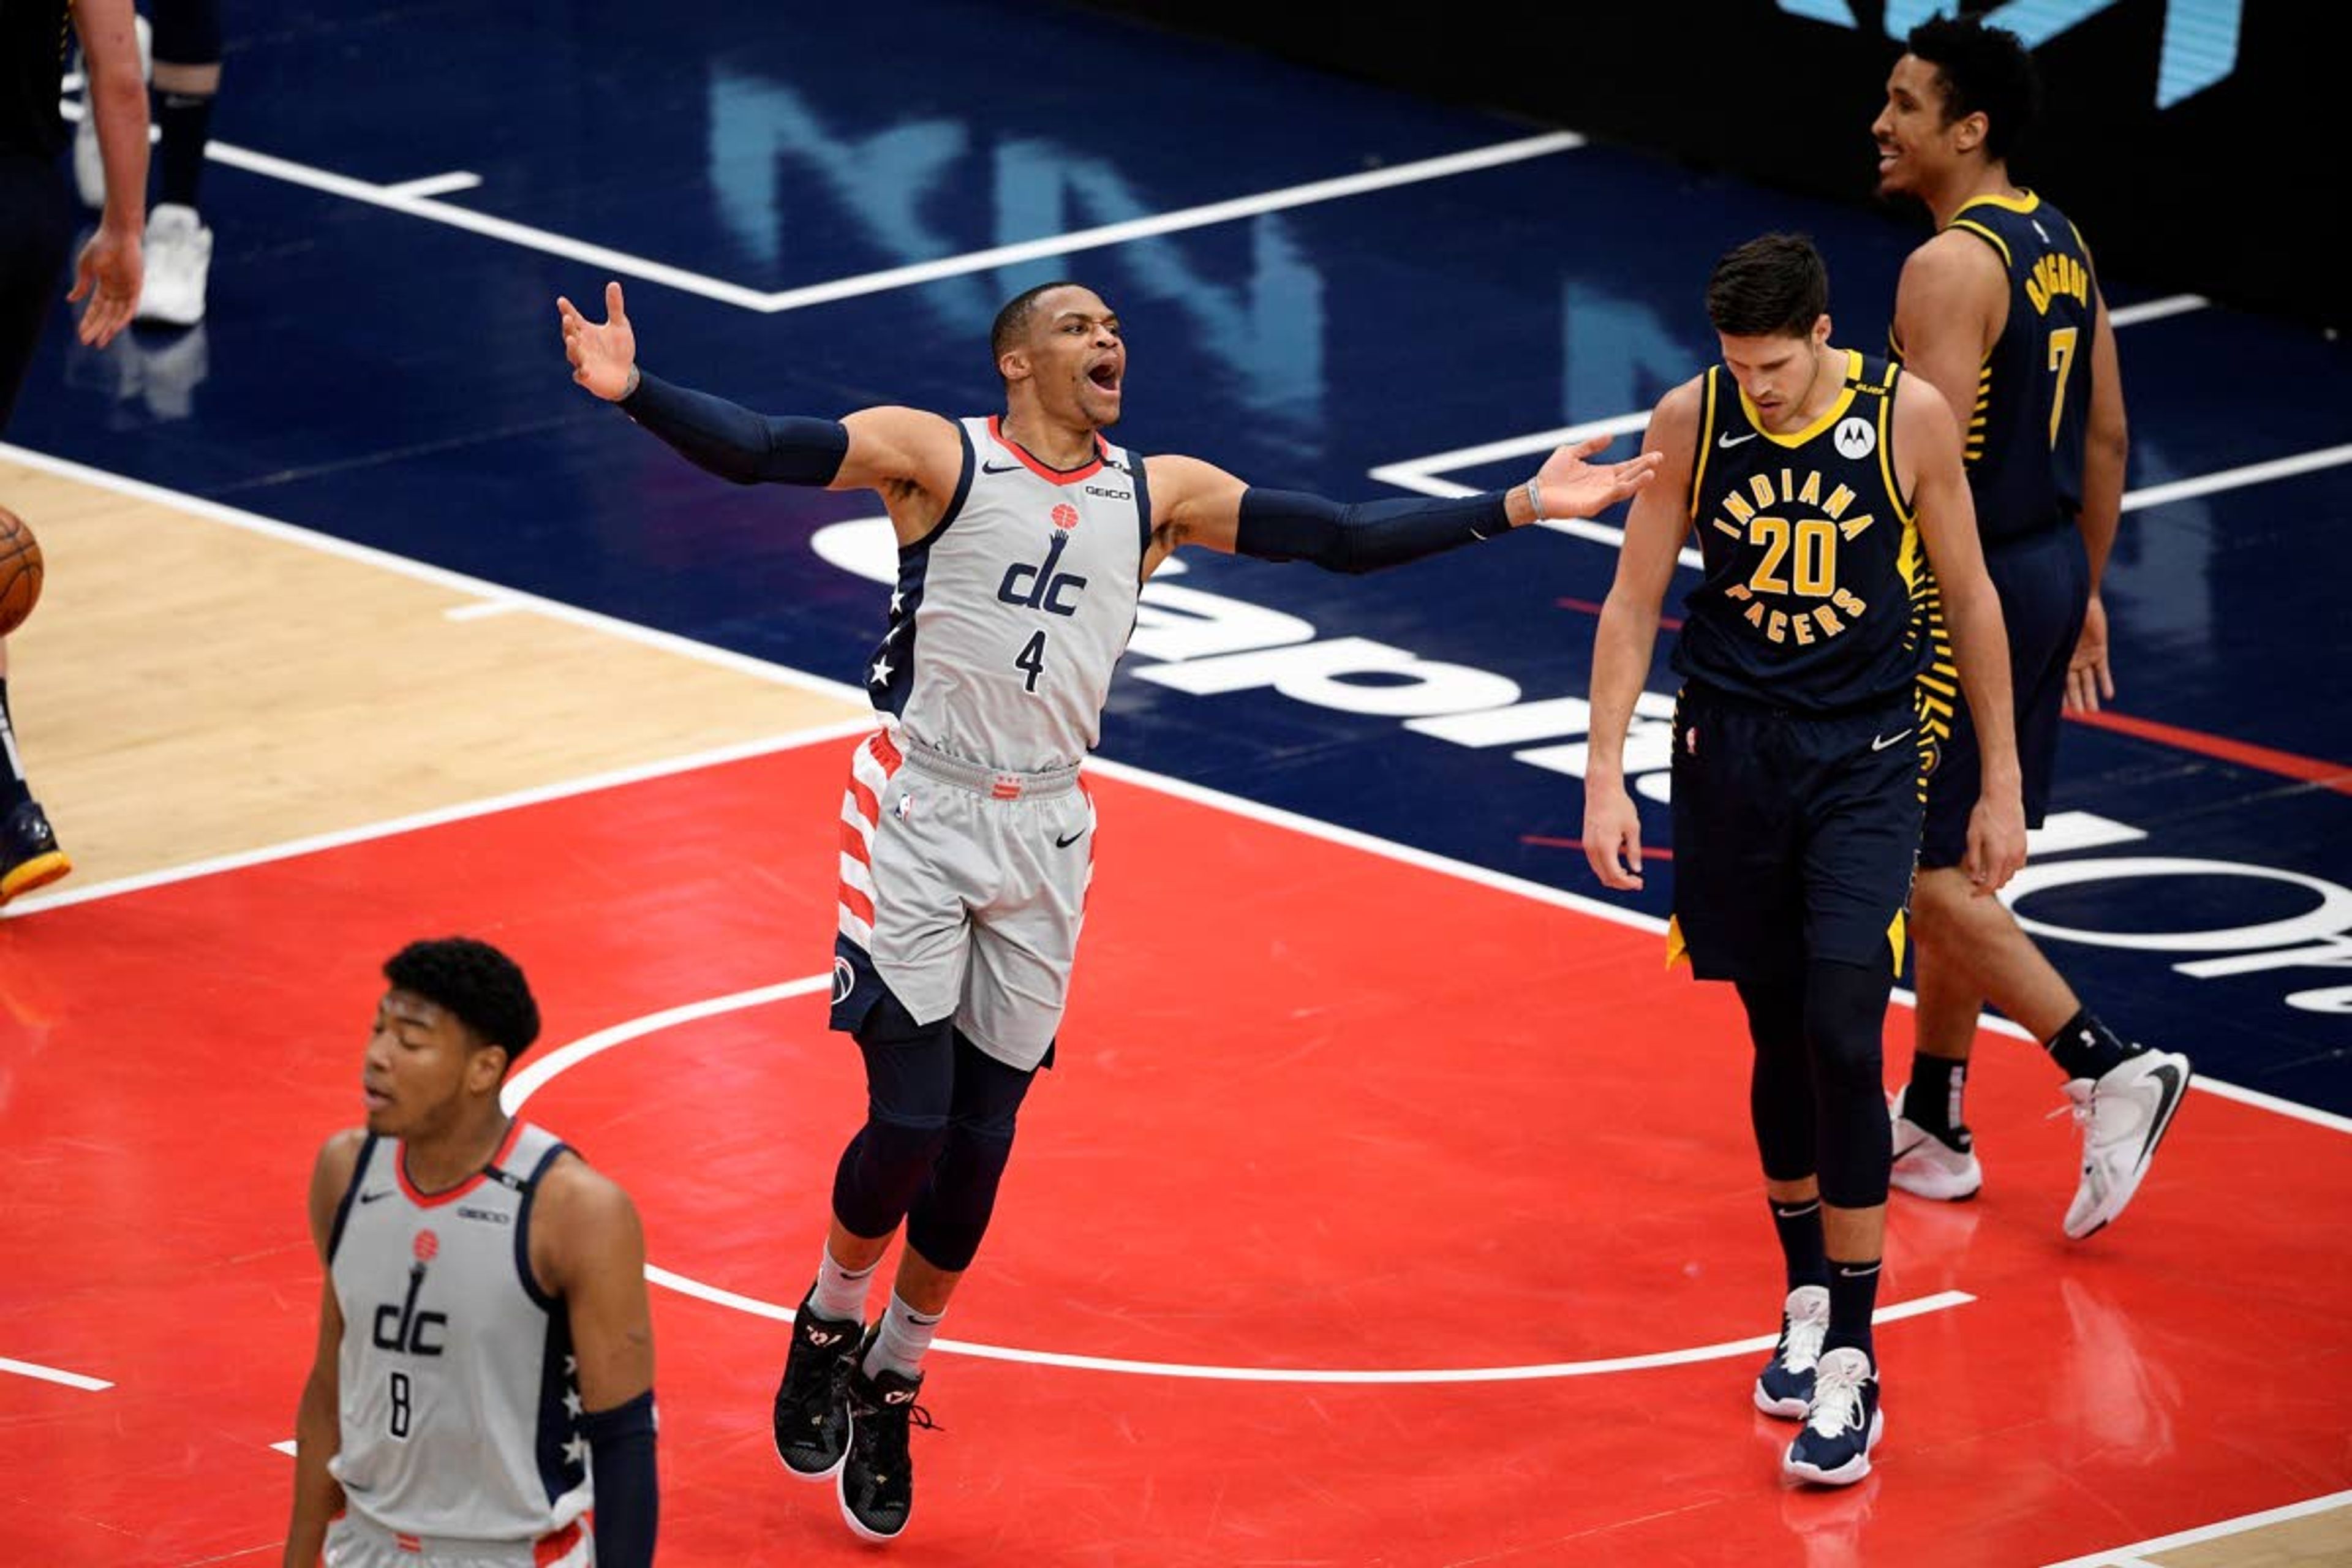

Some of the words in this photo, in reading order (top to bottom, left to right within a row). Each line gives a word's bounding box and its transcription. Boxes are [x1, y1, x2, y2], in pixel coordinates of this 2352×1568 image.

[2049, 326, 2078, 452] 7
[1086, 486, 1131, 500] GEICO
[1713, 469, 1874, 541] INDIANA
[1749, 516, 1837, 597] 20
[1724, 583, 1867, 646] PACERS
[1014, 630, 1046, 693] 4
[390, 1372, 411, 1438] 8
